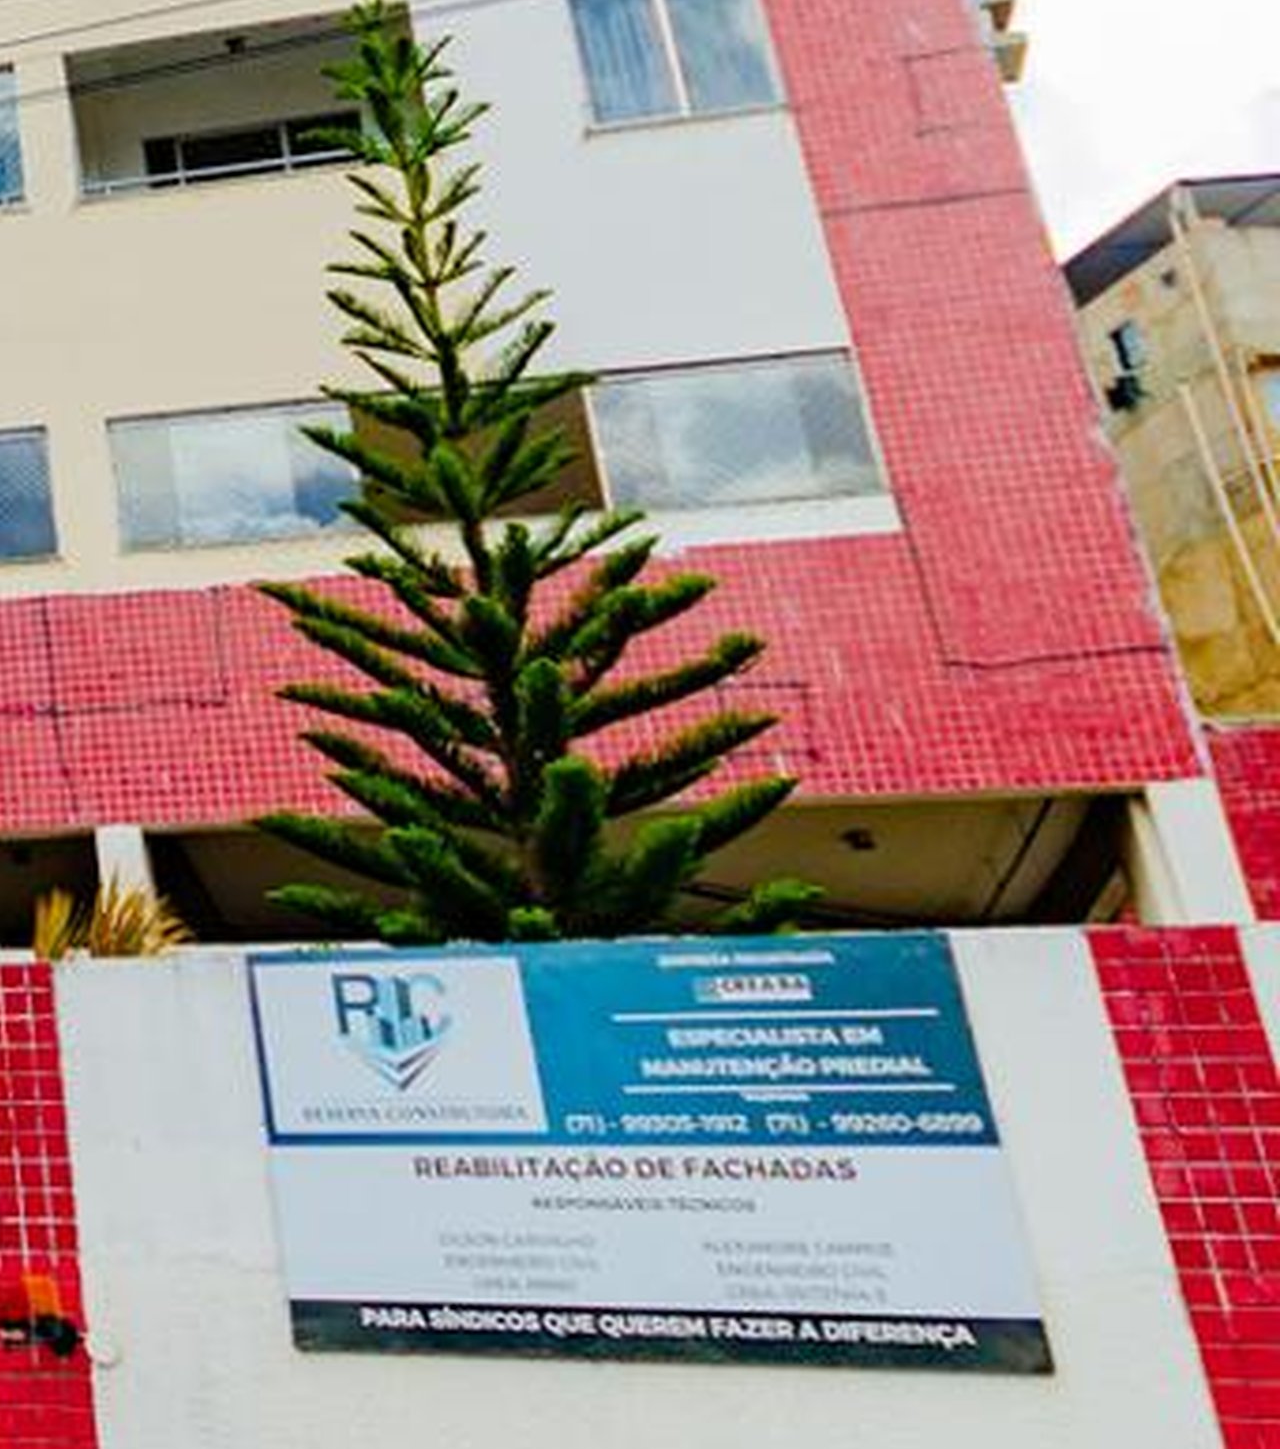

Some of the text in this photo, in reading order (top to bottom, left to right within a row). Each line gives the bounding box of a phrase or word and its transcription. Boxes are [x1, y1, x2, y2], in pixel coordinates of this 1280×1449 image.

[667, 1026, 883, 1047] ESPECIALISTA EM
[641, 1053, 932, 1080] MANUTENÇÃO PREDIAL
[413, 1152, 859, 1182] REABILITAÇÃO DE FACHADAS
[359, 1305, 978, 1349] PARA SÍNDICOS QUE QUEREM FAZER A DIFERENÇA
